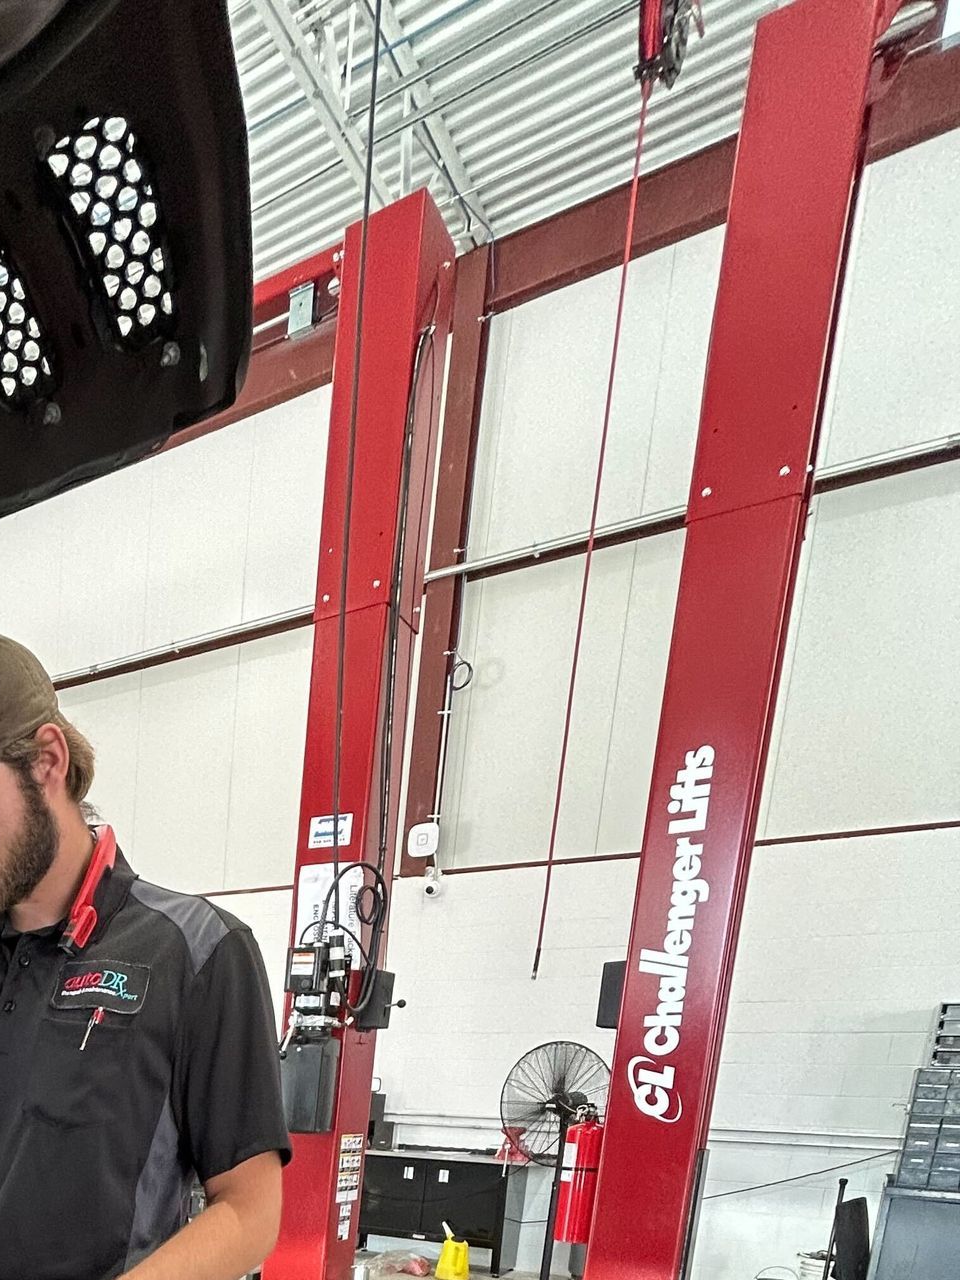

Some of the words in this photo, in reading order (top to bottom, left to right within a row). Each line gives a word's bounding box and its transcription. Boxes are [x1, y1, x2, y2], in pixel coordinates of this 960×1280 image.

[667, 744, 716, 835] Lifts
[348, 884, 358, 928] Literature
[638, 837, 711, 1057] Challenger
